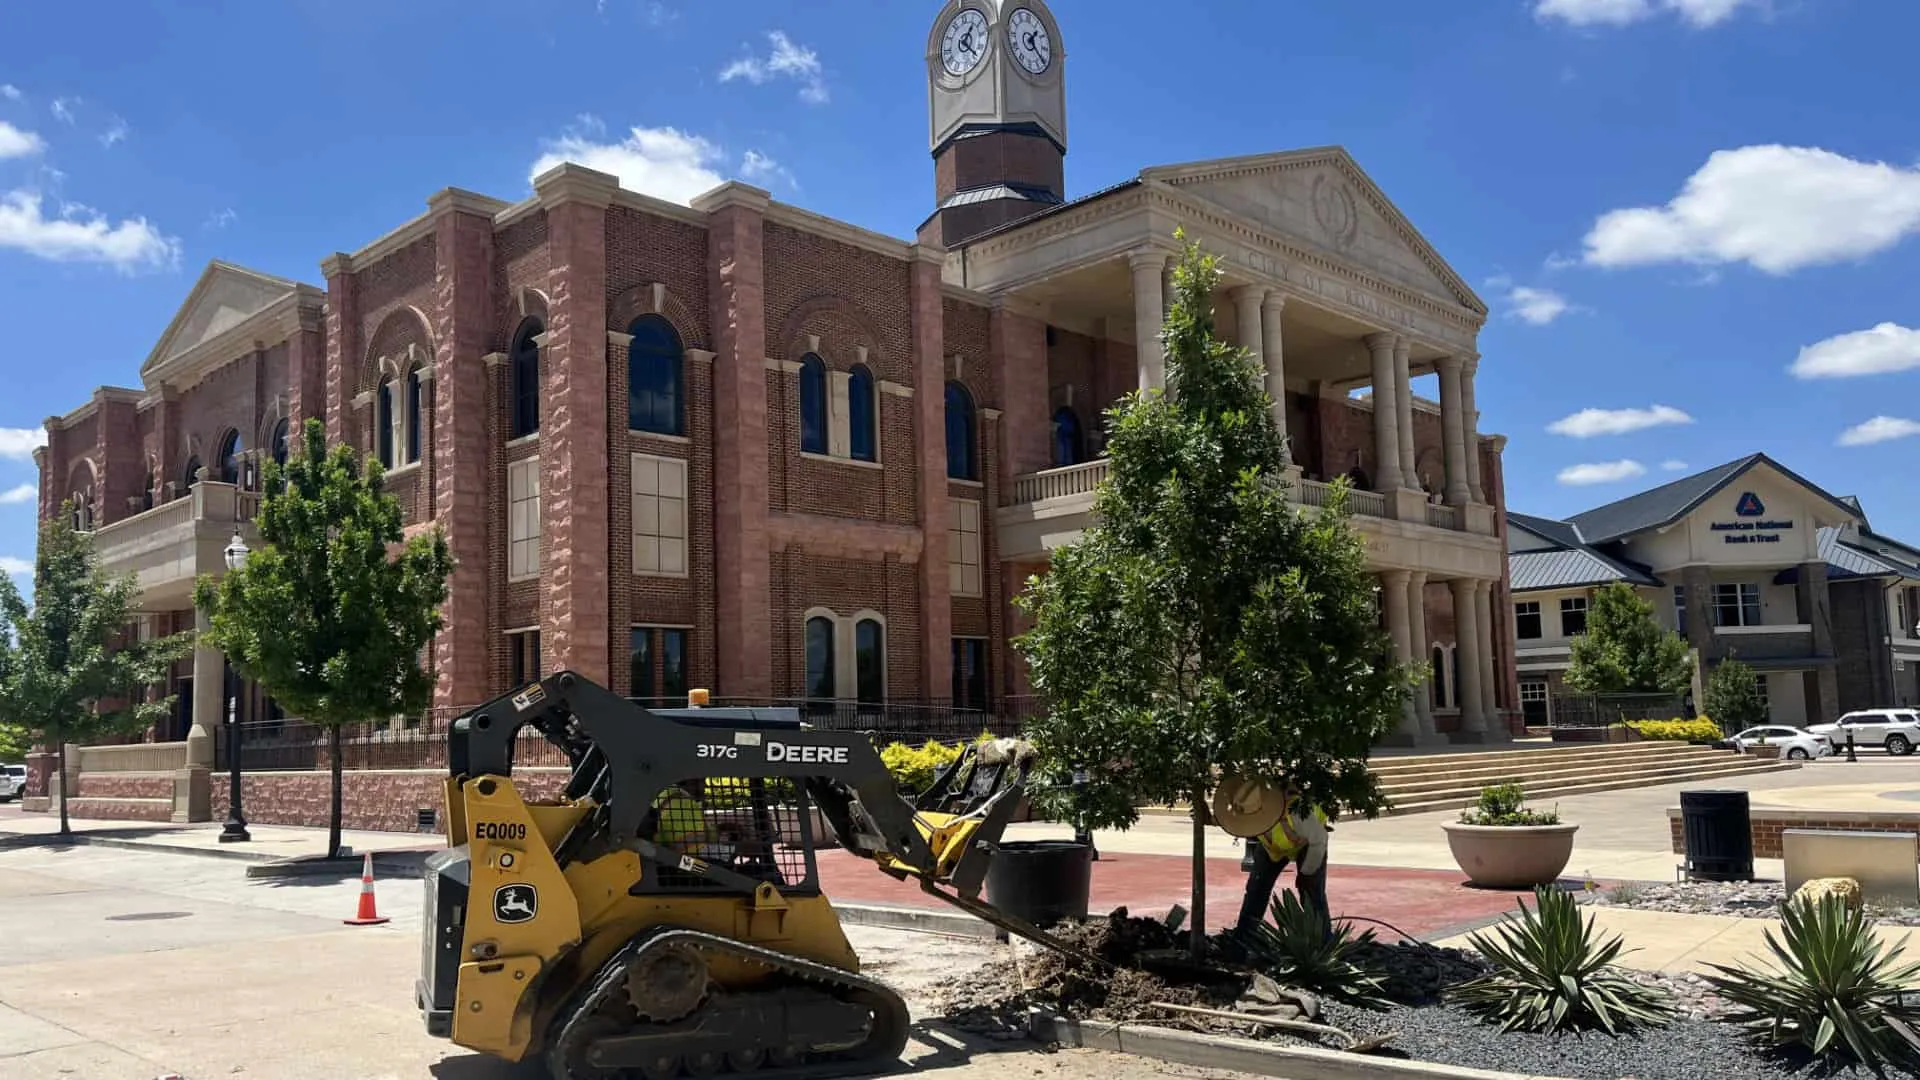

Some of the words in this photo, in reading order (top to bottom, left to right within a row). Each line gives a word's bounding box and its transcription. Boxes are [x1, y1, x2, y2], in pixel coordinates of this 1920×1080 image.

[1711, 521, 1754, 530] American
[1756, 520, 1793, 529] National
[1725, 535, 1748, 544] Bank
[1757, 534, 1779, 543] Trust
[697, 744, 737, 758] 317G
[767, 741, 849, 763] DEERE
[476, 822, 526, 839] EQ009
